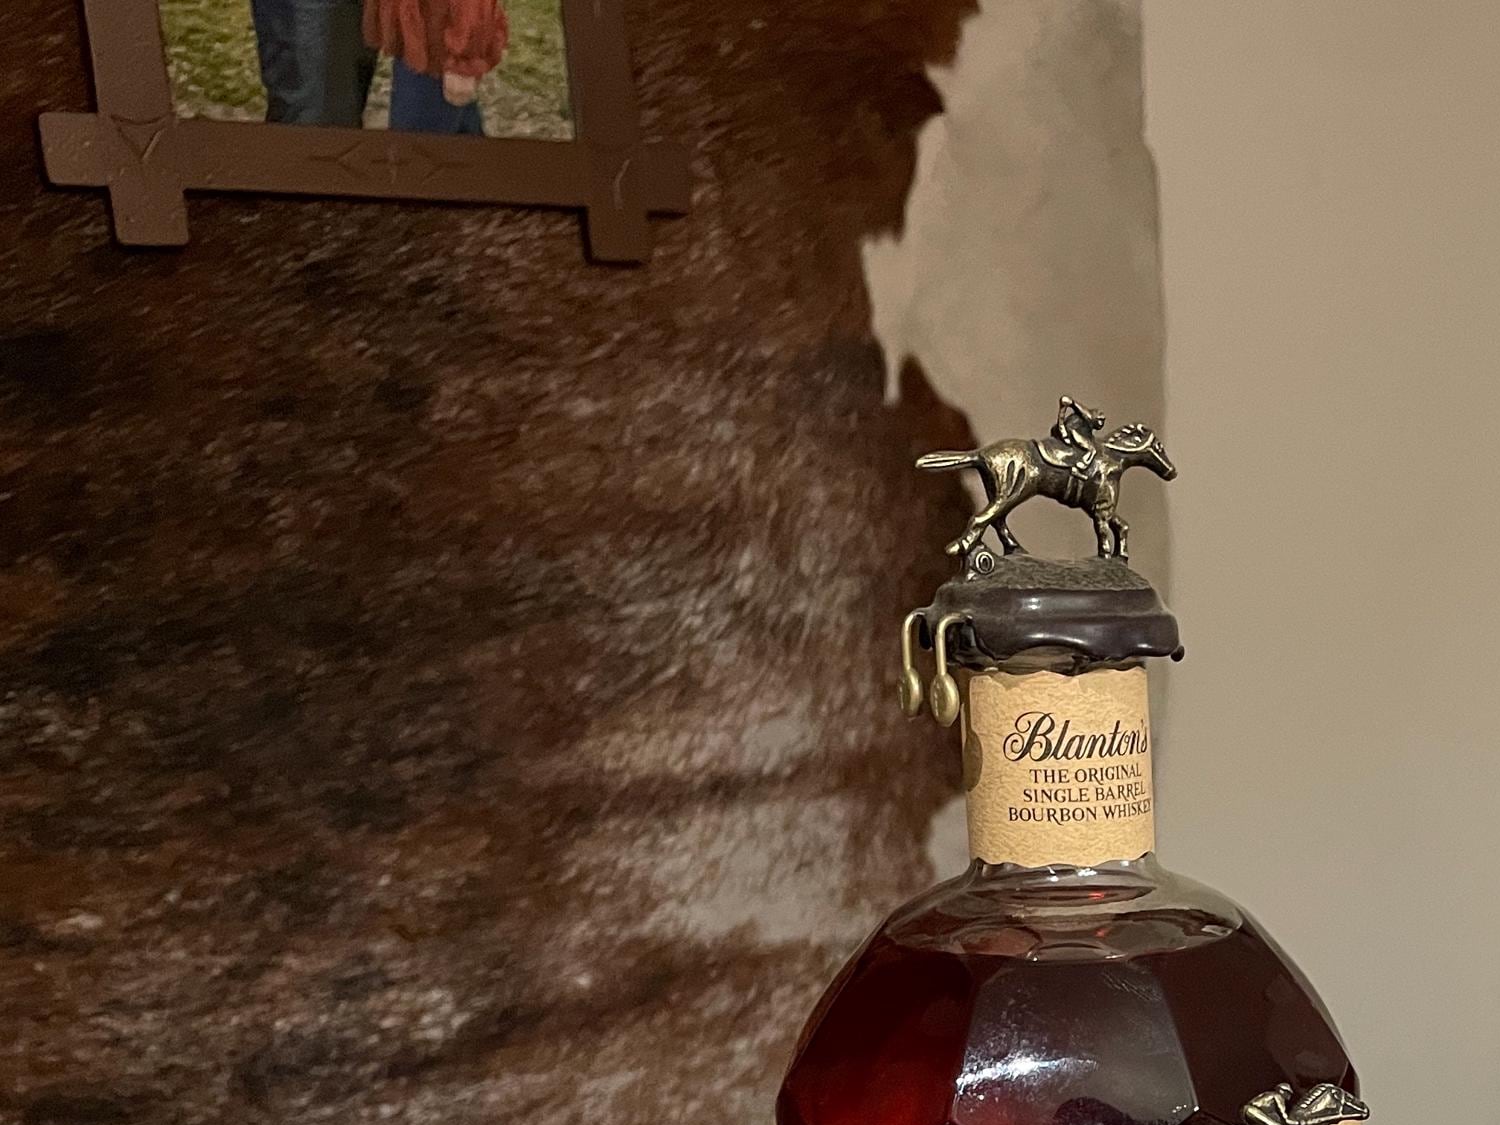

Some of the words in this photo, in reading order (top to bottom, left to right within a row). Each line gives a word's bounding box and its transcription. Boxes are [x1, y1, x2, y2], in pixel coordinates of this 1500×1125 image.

[1003, 711, 1148, 762] Blanton's
[1029, 768, 1069, 785] THE
[1074, 763, 1143, 786] ORIGINAL
[1023, 787, 1090, 803] SINGLE
[1095, 781, 1146, 802] BARREL
[1008, 805, 1098, 827] BOURBON
